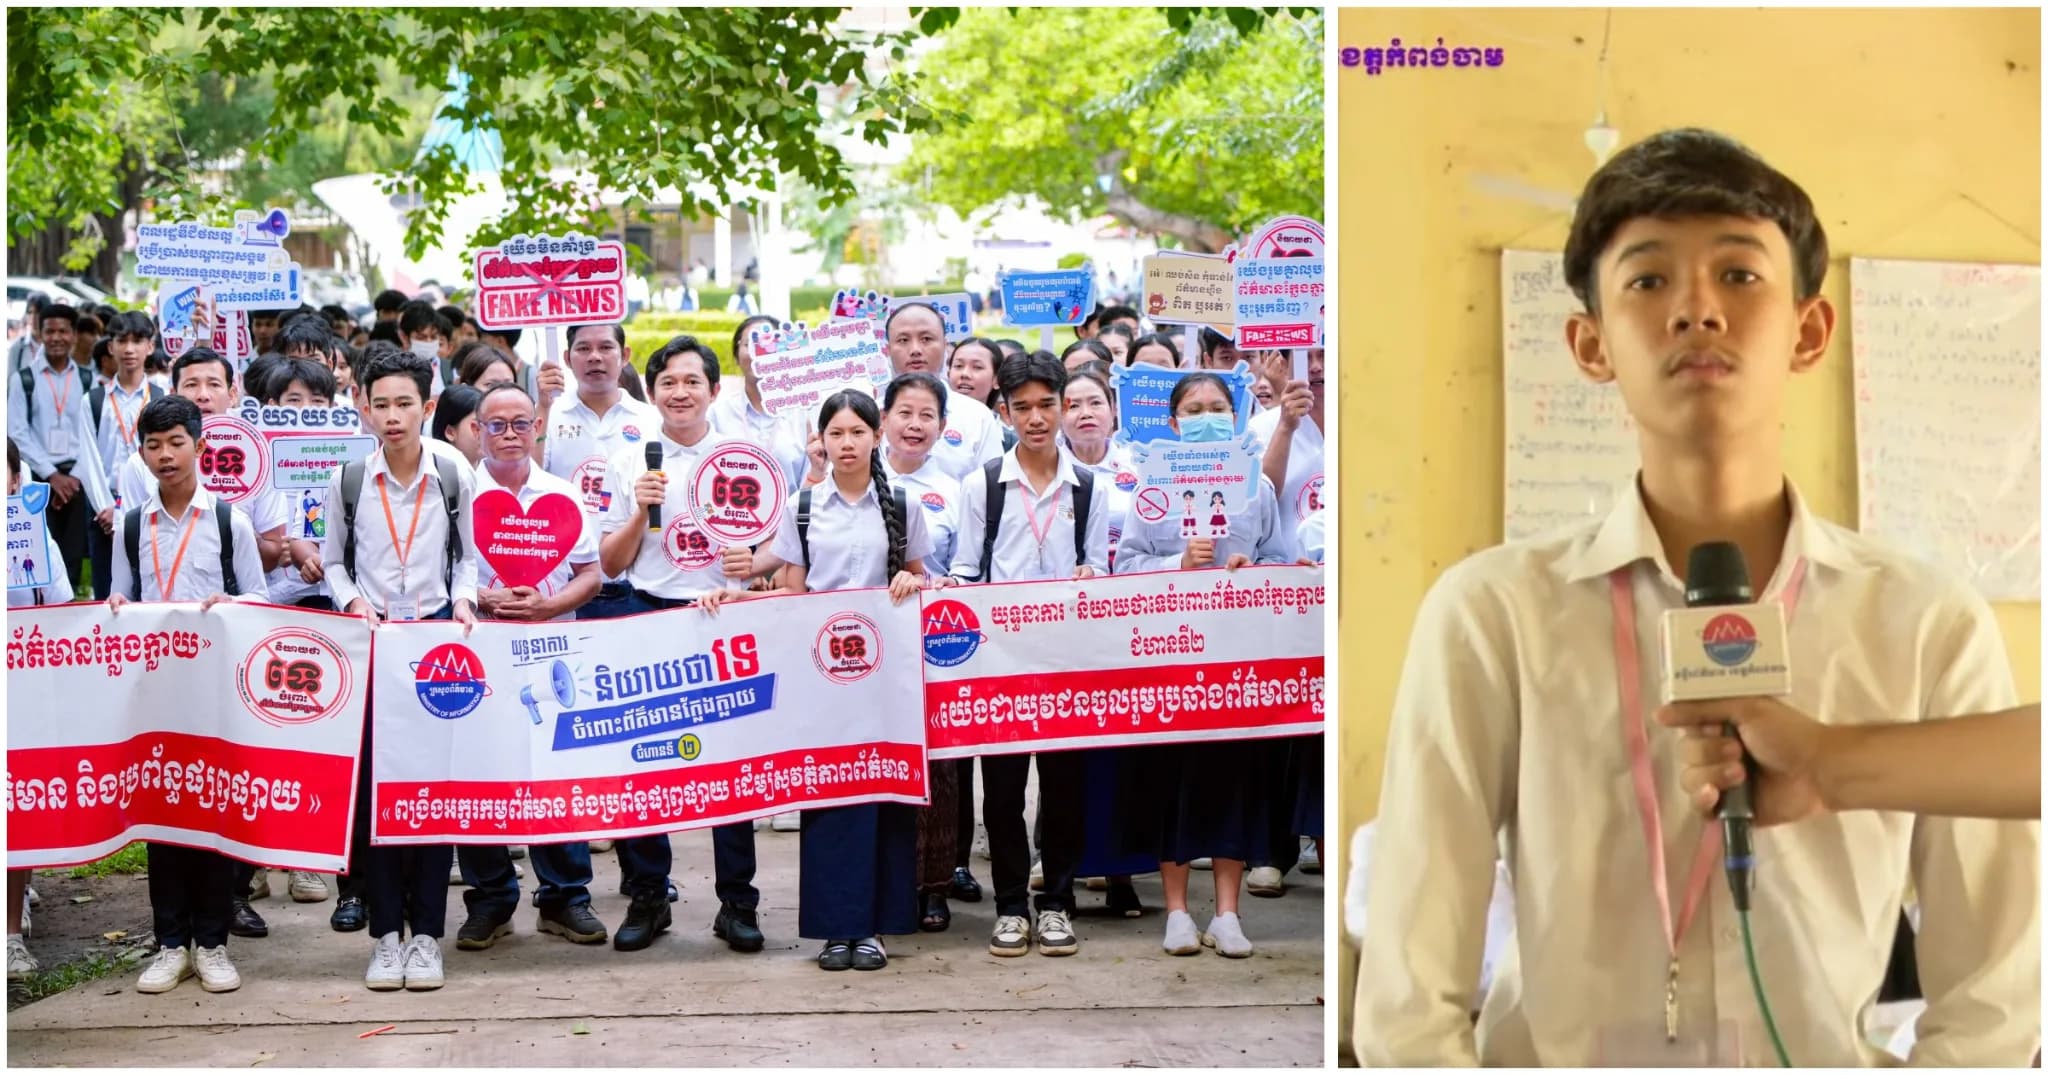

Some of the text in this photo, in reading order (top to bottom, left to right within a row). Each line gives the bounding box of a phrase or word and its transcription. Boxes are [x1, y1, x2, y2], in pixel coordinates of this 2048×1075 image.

[503, 236, 595, 255] យើងមិនគាំទ្រ
[1238, 262, 1324, 280] យើងរួមគ្នាលុប
[487, 287, 616, 318] FAKE NEWS
[1246, 329, 1309, 343] FAKE NEWS
[241, 399, 360, 427] និយាយថា
[201, 446, 246, 475] ទេ
[719, 458, 759, 471] និយាយថា
[713, 475, 761, 509] ទេ
[724, 506, 749, 519] ចំពោះ
[991, 604, 1065, 632] យុទ្ធនាការ
[275, 641, 321, 655] និយាយថា
[511, 635, 569, 662] យុទ្ធនាការ
[829, 635, 867, 660] ទេ
[265, 659, 323, 693] ទេ
[279, 690, 308, 702] ចំពោះ
